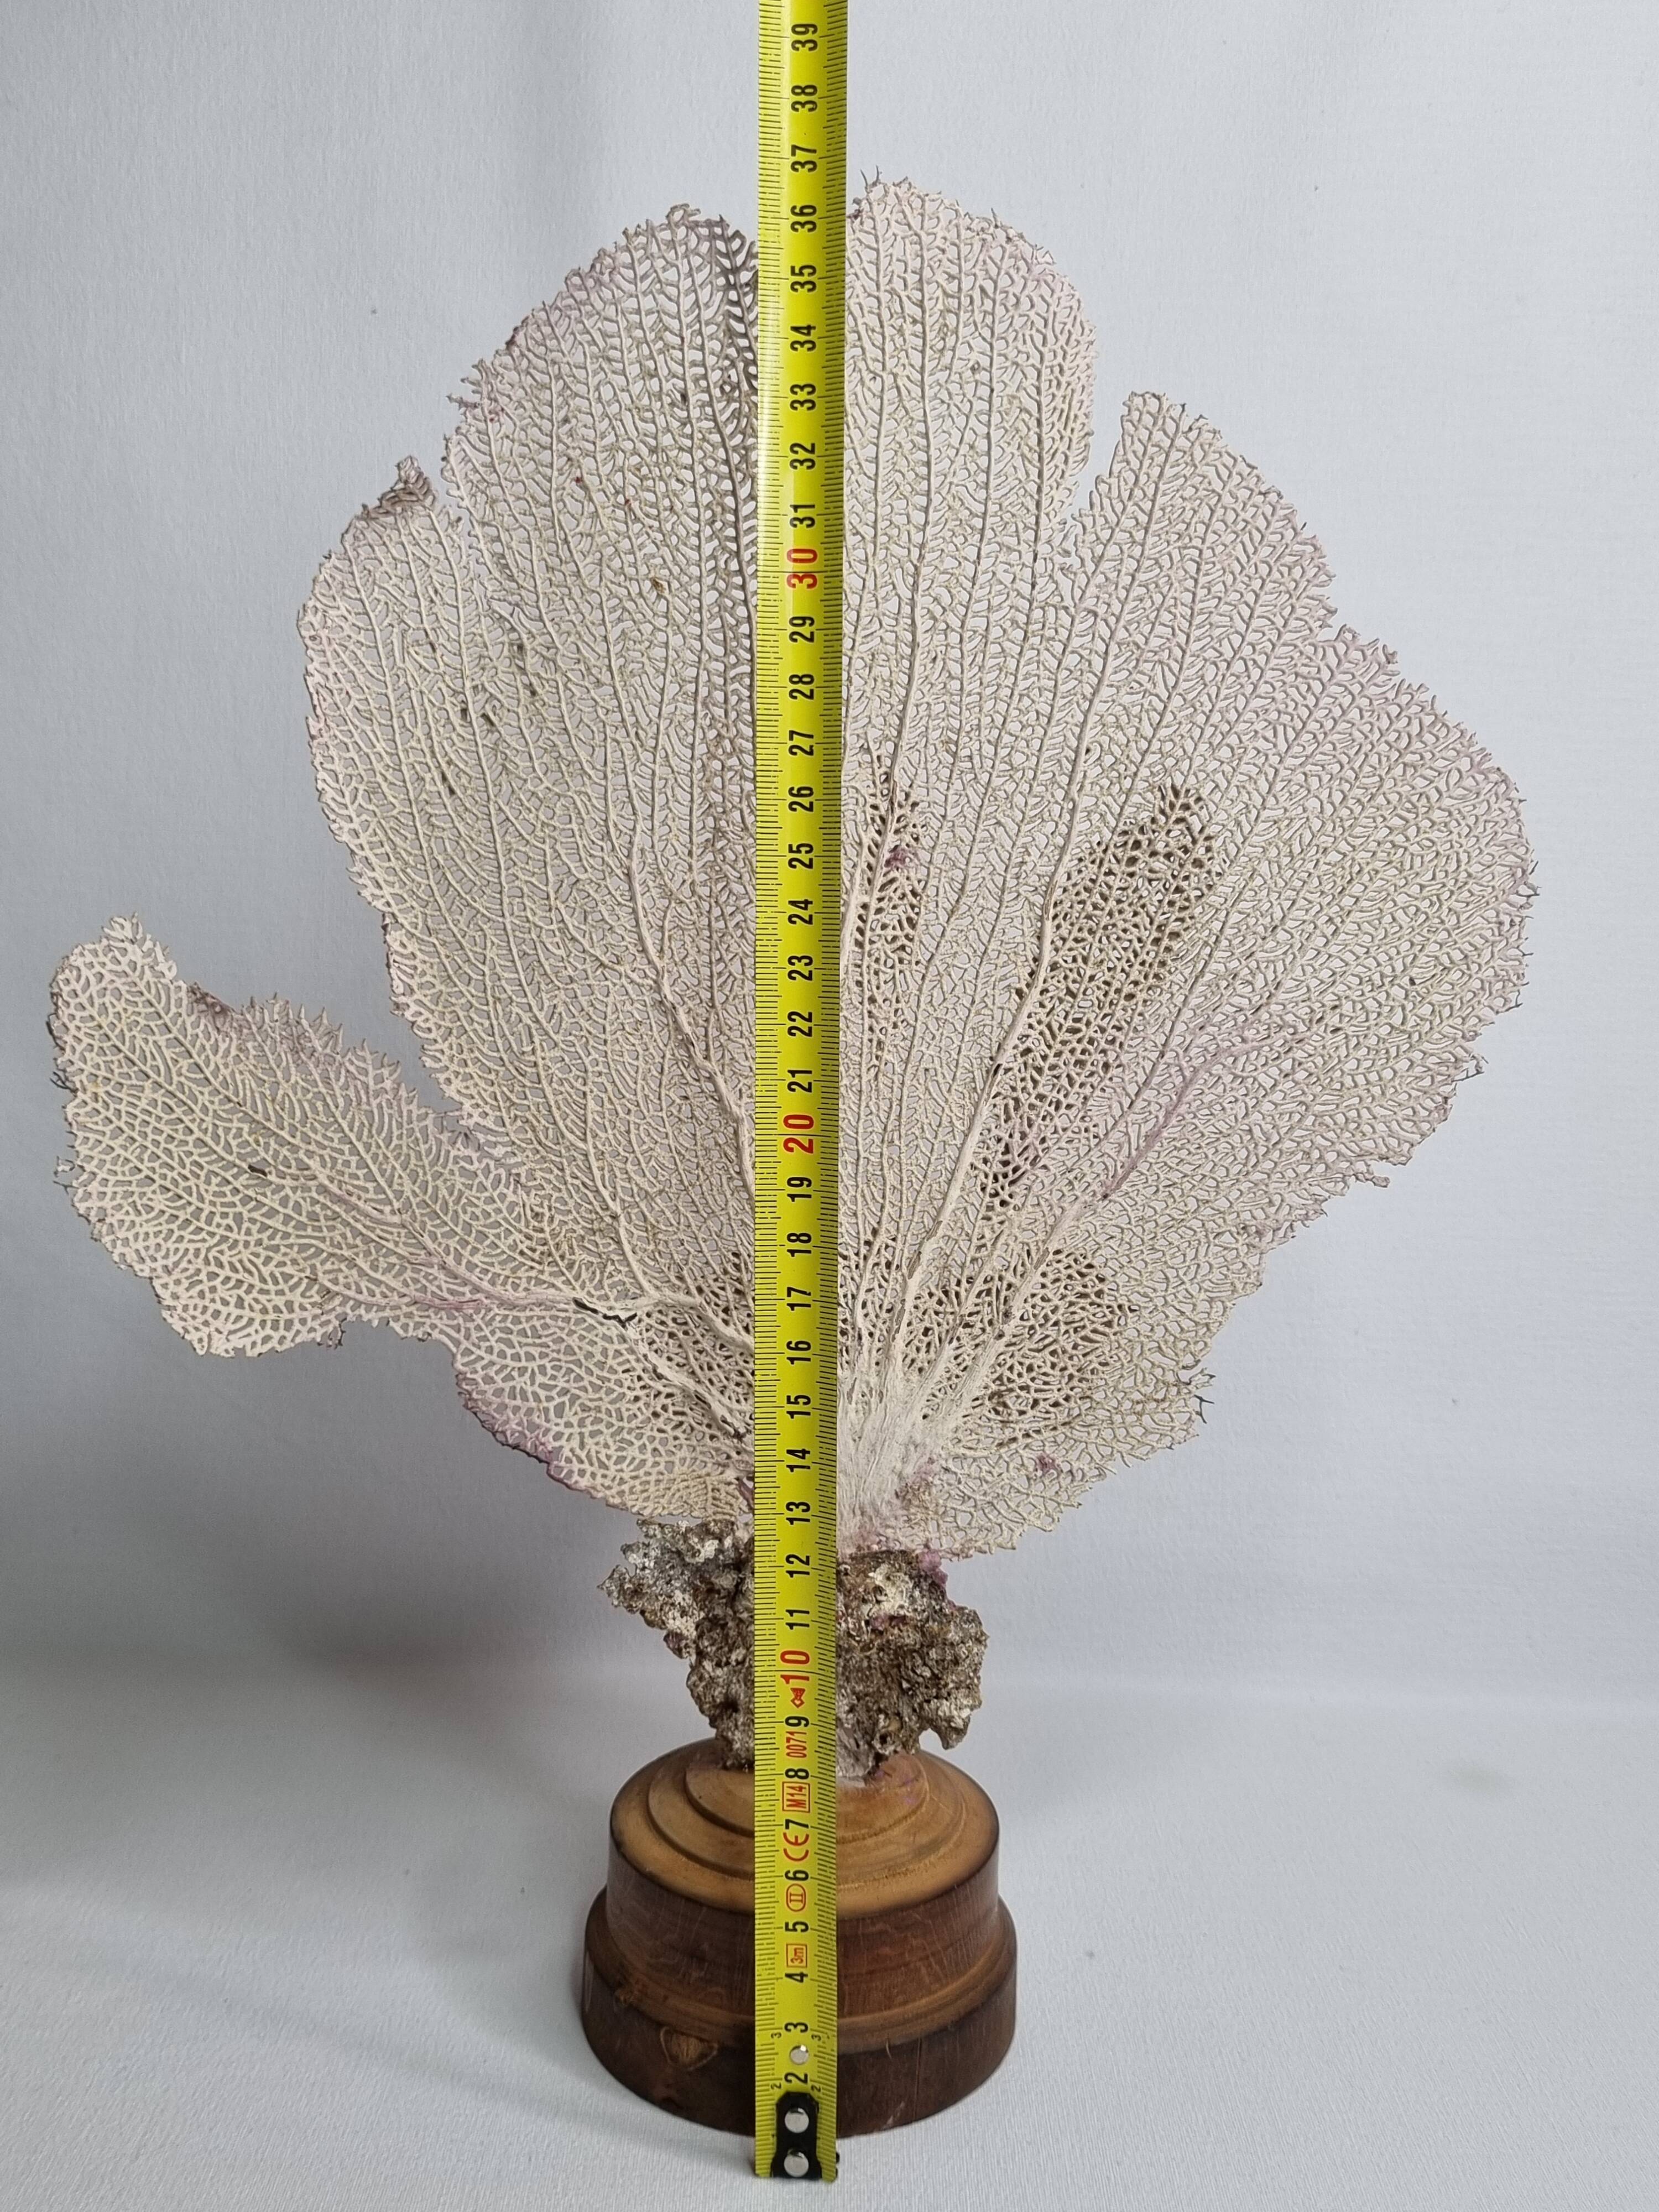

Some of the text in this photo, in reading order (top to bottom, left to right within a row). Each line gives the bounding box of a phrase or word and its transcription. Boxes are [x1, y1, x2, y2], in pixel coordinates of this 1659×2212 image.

[791, 23, 818, 51] 39
[791, 85, 818, 112] 38
[791, 145, 817, 173] 37
[790, 205, 817, 232] 36
[790, 264, 817, 293] 35
[790, 324, 816, 352] 34
[790, 383, 816, 411] 33
[790, 442, 816, 470] 32
[790, 504, 816, 528] 31
[787, 548, 818, 589] 30
[789, 616, 815, 643] 29
[789, 674, 815, 700] 28
[788, 730, 814, 756] 27
[788, 786, 814, 812] 26
[787, 843, 814, 869] 25
[787, 899, 813, 925] 24
[787, 955, 813, 981] 23
[787, 1011, 813, 1037] 22
[787, 1070, 812, 1093] 21
[782, 1114, 815, 1154] 20
[786, 1177, 812, 1202] 19
[786, 1232, 812, 1258] 18
[786, 1286, 812, 1311] 17
[786, 1340, 811, 1365] 16
[786, 1395, 811, 1419] 15
[786, 1448, 811, 1473] 14
[785, 1501, 811, 1525] 13
[785, 1554, 810, 1578] 12
[785, 1609, 810, 1630] 11
[780, 1650, 810, 1684] 10
[785, 1716, 810, 1728] 9
[785, 1731, 807, 1759] 0071
[785, 1768, 810, 1780] 8
[786, 1785, 807, 1809] M14
[785, 1819, 809, 1830] 7
[784, 1870, 809, 1881] 6
[785, 1921, 809, 1933] 5
[789, 1947, 805, 1965] 3m
[785, 1971, 808, 1984] 4
[784, 2022, 808, 2033] 3
[784, 2072, 808, 2085] 2
[810, 2085, 822, 2093] 2
